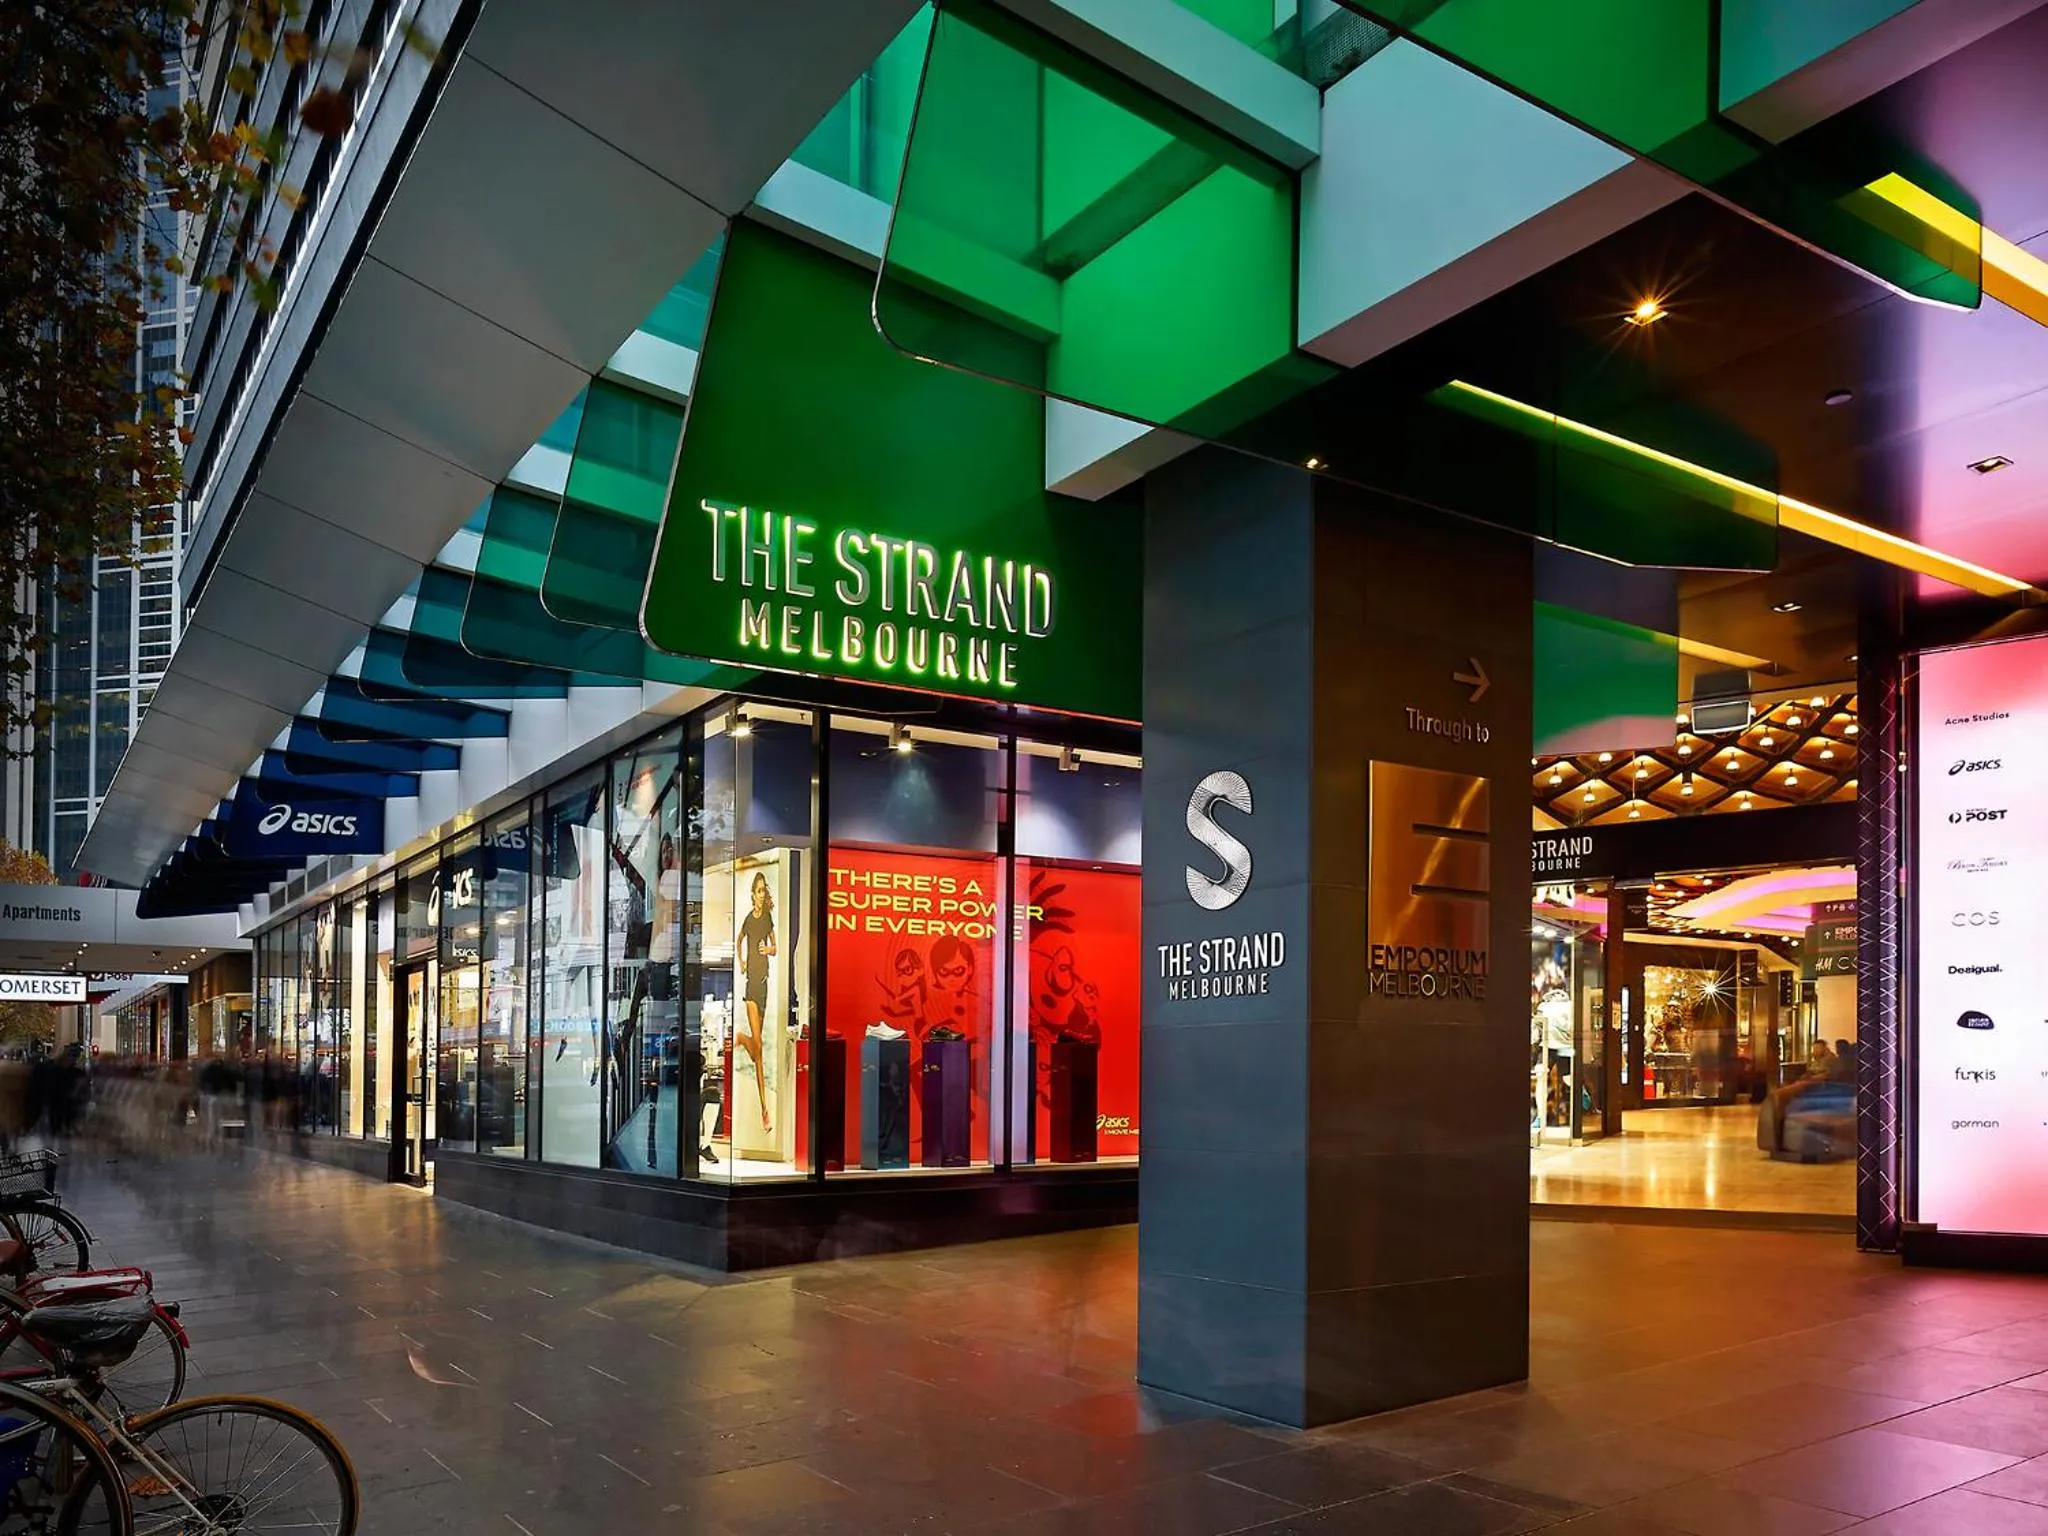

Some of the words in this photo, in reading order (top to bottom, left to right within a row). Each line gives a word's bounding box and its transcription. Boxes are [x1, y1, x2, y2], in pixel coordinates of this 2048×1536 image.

[701, 498, 816, 596] THE
[834, 527, 1056, 640] STRAND
[740, 597, 1020, 687] MELBOURNE
[1404, 706, 1472, 741] Through
[1476, 722, 1490, 743] to
[1944, 716, 1970, 726] Acne
[1972, 712, 2011, 723] Studios
[1965, 809, 2008, 823] POST
[1185, 769, 1254, 912] S
[829, 867, 958, 896] THERE'S
[962, 879, 984, 897] A
[2, 903, 82, 922] Apartments
[828, 891, 933, 914] SUPER
[827, 915, 858, 932] IN
[1950, 911, 2001, 927] COS
[1158, 942, 1194, 979] THE
[1199, 931, 1286, 975] STRAND
[1370, 943, 1488, 975] EMPORIUM
[1169, 972, 1271, 1001] MELBOURNE
[1369, 972, 1487, 999] MELBOURNE
[1954, 1067, 1997, 1084] funkis
[1951, 1119, 2000, 1130] gorman
